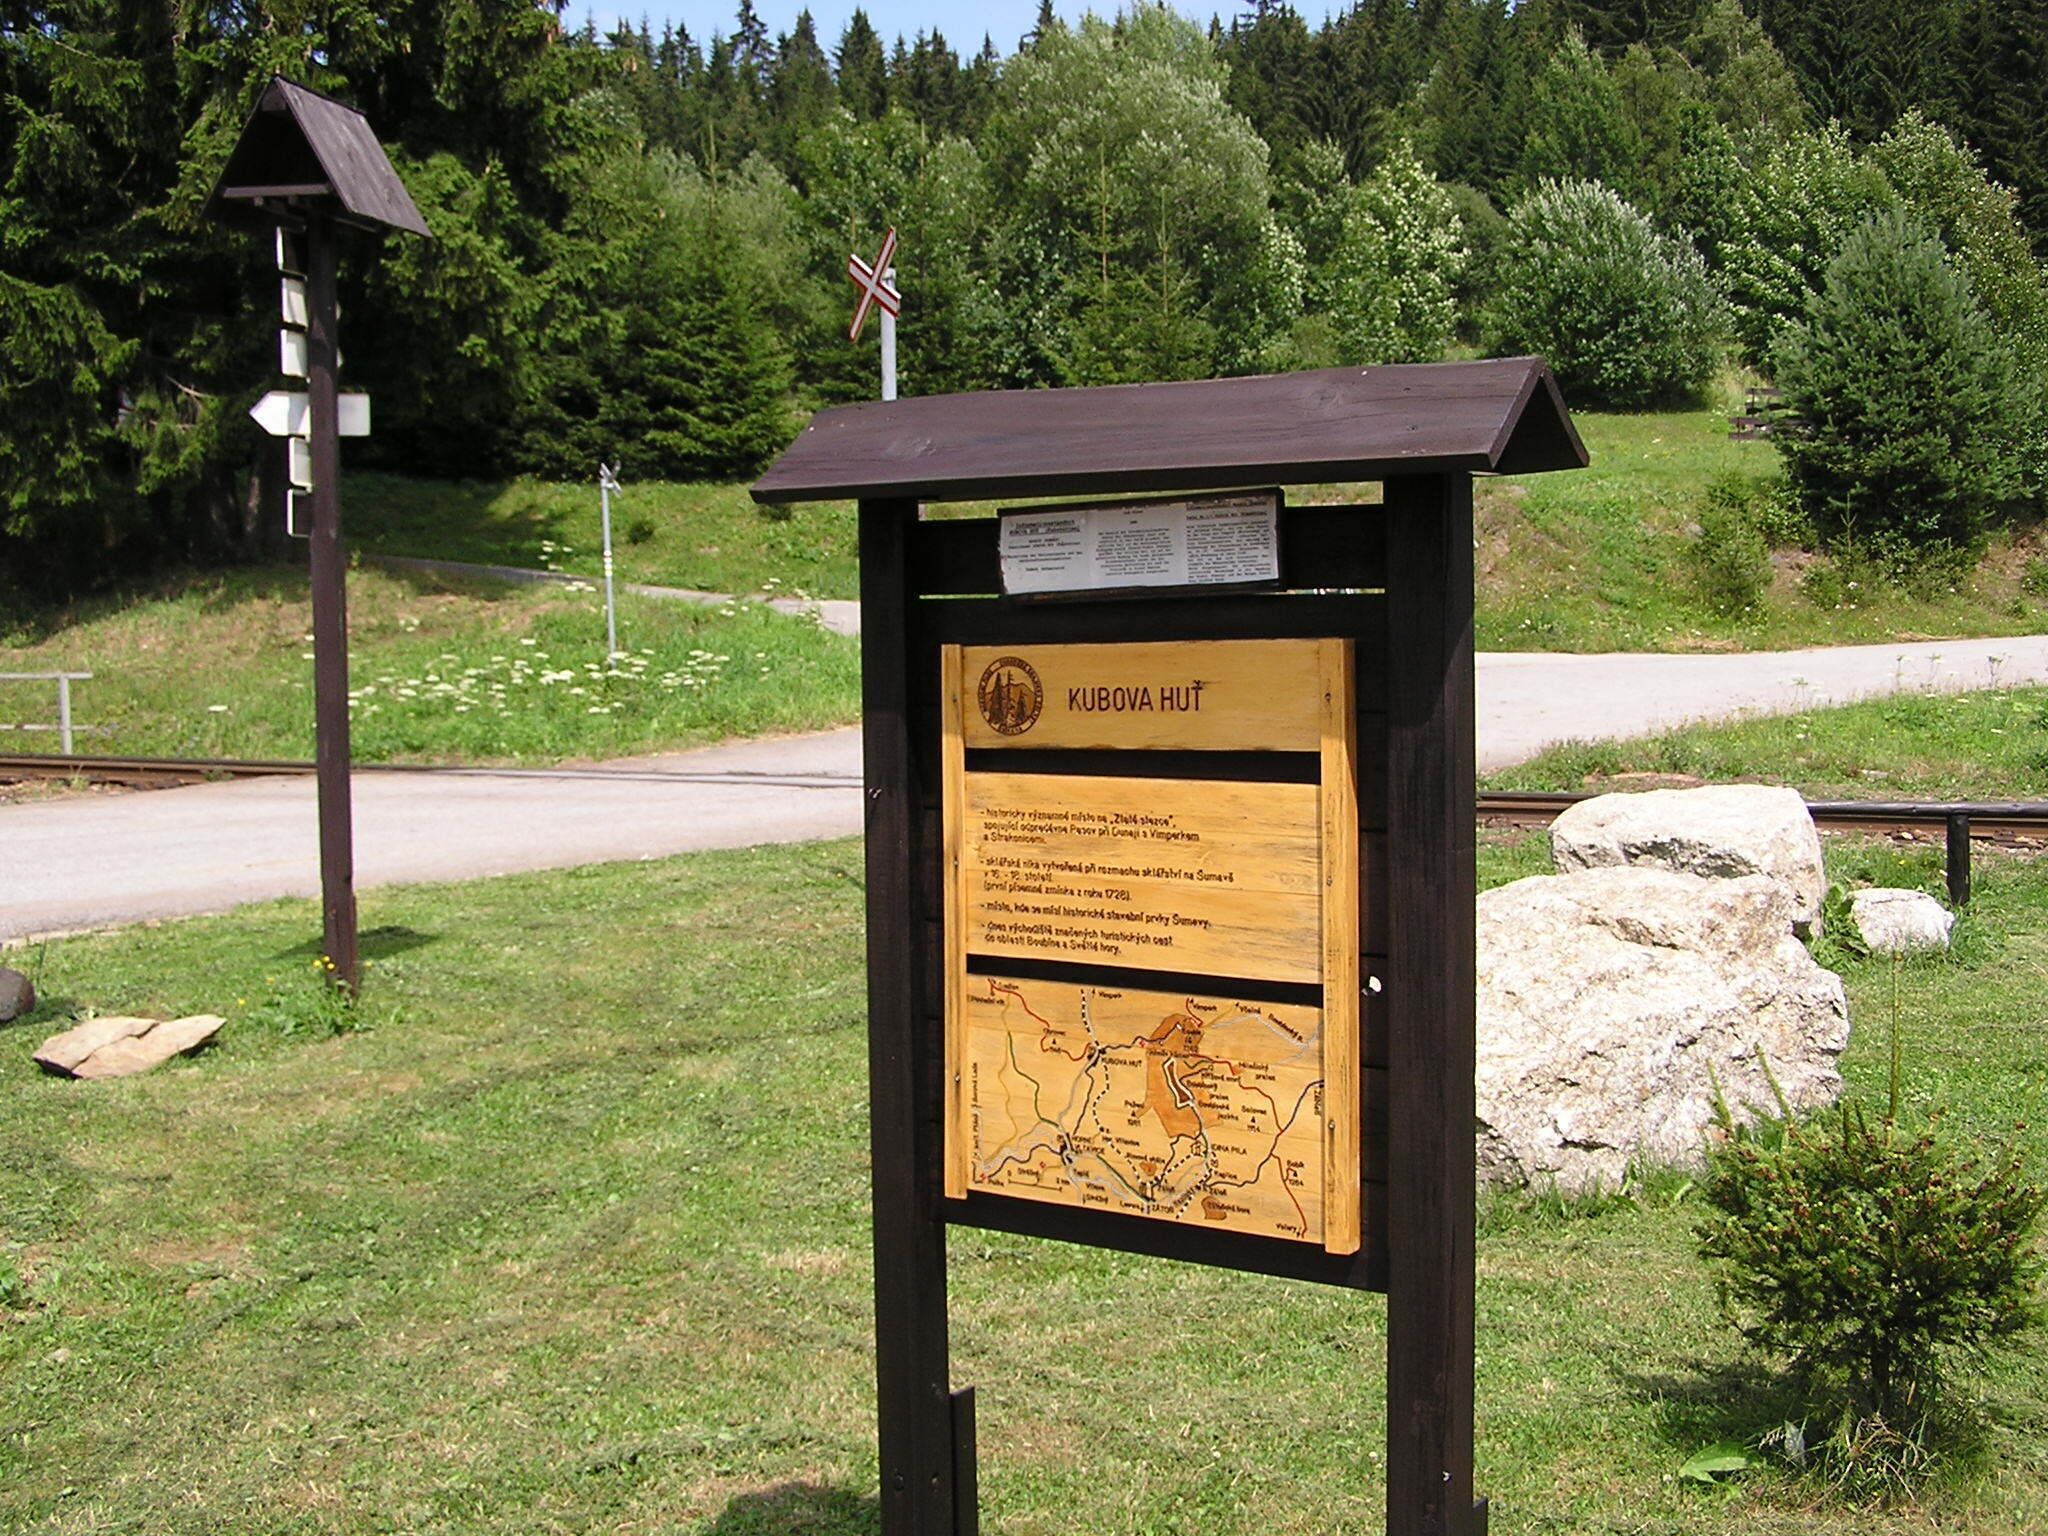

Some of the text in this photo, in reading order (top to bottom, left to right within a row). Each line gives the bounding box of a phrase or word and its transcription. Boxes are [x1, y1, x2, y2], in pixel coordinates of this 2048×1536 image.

[1068, 679, 1203, 712] KUBOVA HUŤ
[1071, 811, 1095, 822] místo
[1097, 815, 1107, 823] na
[1070, 824, 1096, 835] Pasov
[1098, 825, 1110, 837] při
[1149, 829, 1200, 842] Vimperkem
[1042, 861, 1083, 873] vytvořená
[1085, 863, 1096, 874] při
[1098, 866, 1140, 877] rozmachu
[1184, 871, 1194, 880] na
[1196, 869, 1234, 882] Šumavě
[1083, 888, 1103, 898] roku
[1063, 906, 1105, 919] historické
[1107, 910, 1144, 922] stavební
[1146, 913, 1170, 926] prvky
[1100, 930, 1151, 945] turistických
[1153, 936, 1174, 946] cest
